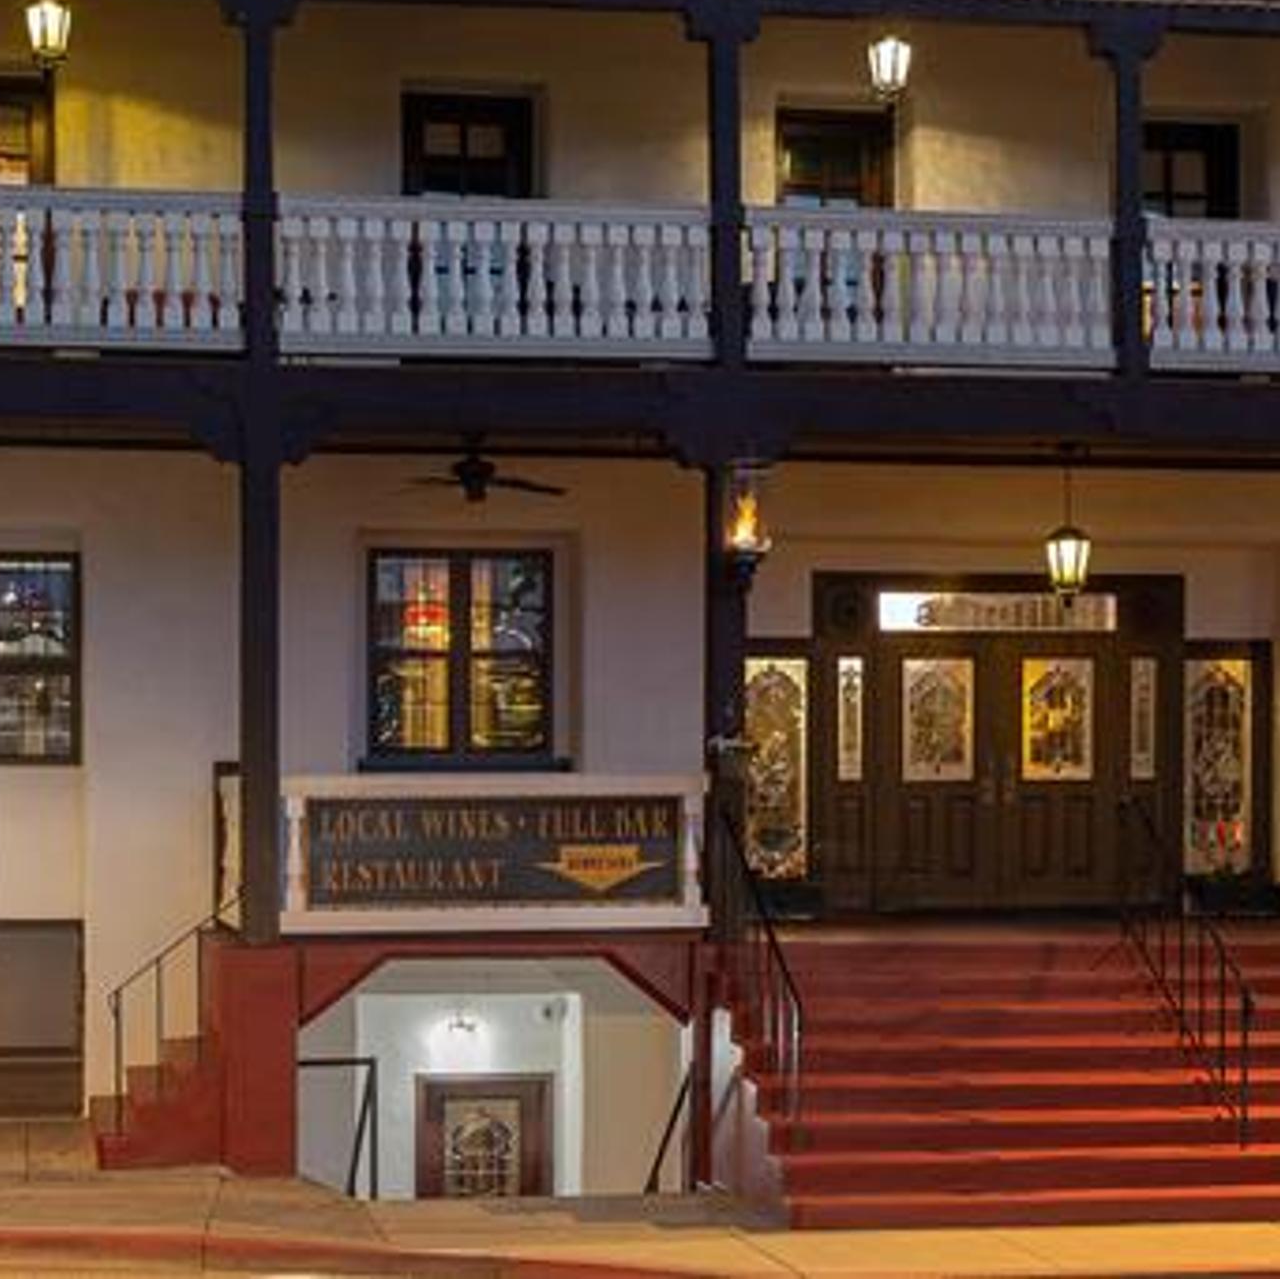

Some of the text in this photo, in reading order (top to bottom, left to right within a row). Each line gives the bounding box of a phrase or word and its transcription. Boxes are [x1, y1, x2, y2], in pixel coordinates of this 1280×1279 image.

[322, 806, 670, 842] LOCAL WINES FULL BAR
[325, 858, 503, 893] RESTAURANT
